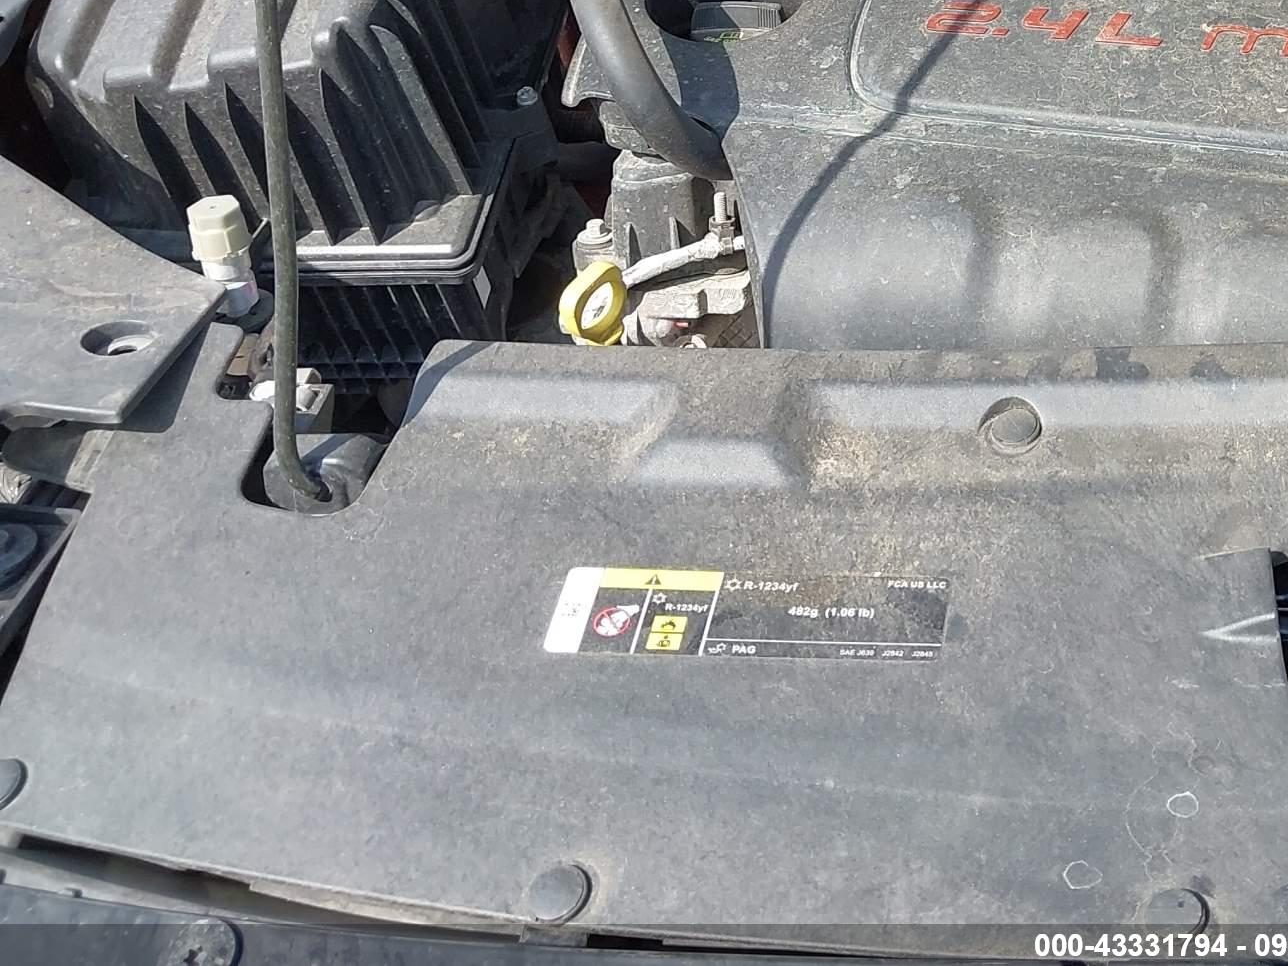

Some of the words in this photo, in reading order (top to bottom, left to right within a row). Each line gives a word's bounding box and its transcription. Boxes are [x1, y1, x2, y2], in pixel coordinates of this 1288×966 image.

[743, 580, 800, 593] R-1234yf
[887, 580, 908, 589] FCA
[910, 580, 925, 589] US
[926, 580, 947, 589] LLC
[664, 602, 709, 614] R-1234yf
[824, 606, 856, 619] (1.06
[858, 606, 875, 619] lb)
[732, 644, 757, 655] PAG
[839, 648, 856, 656] SAE
